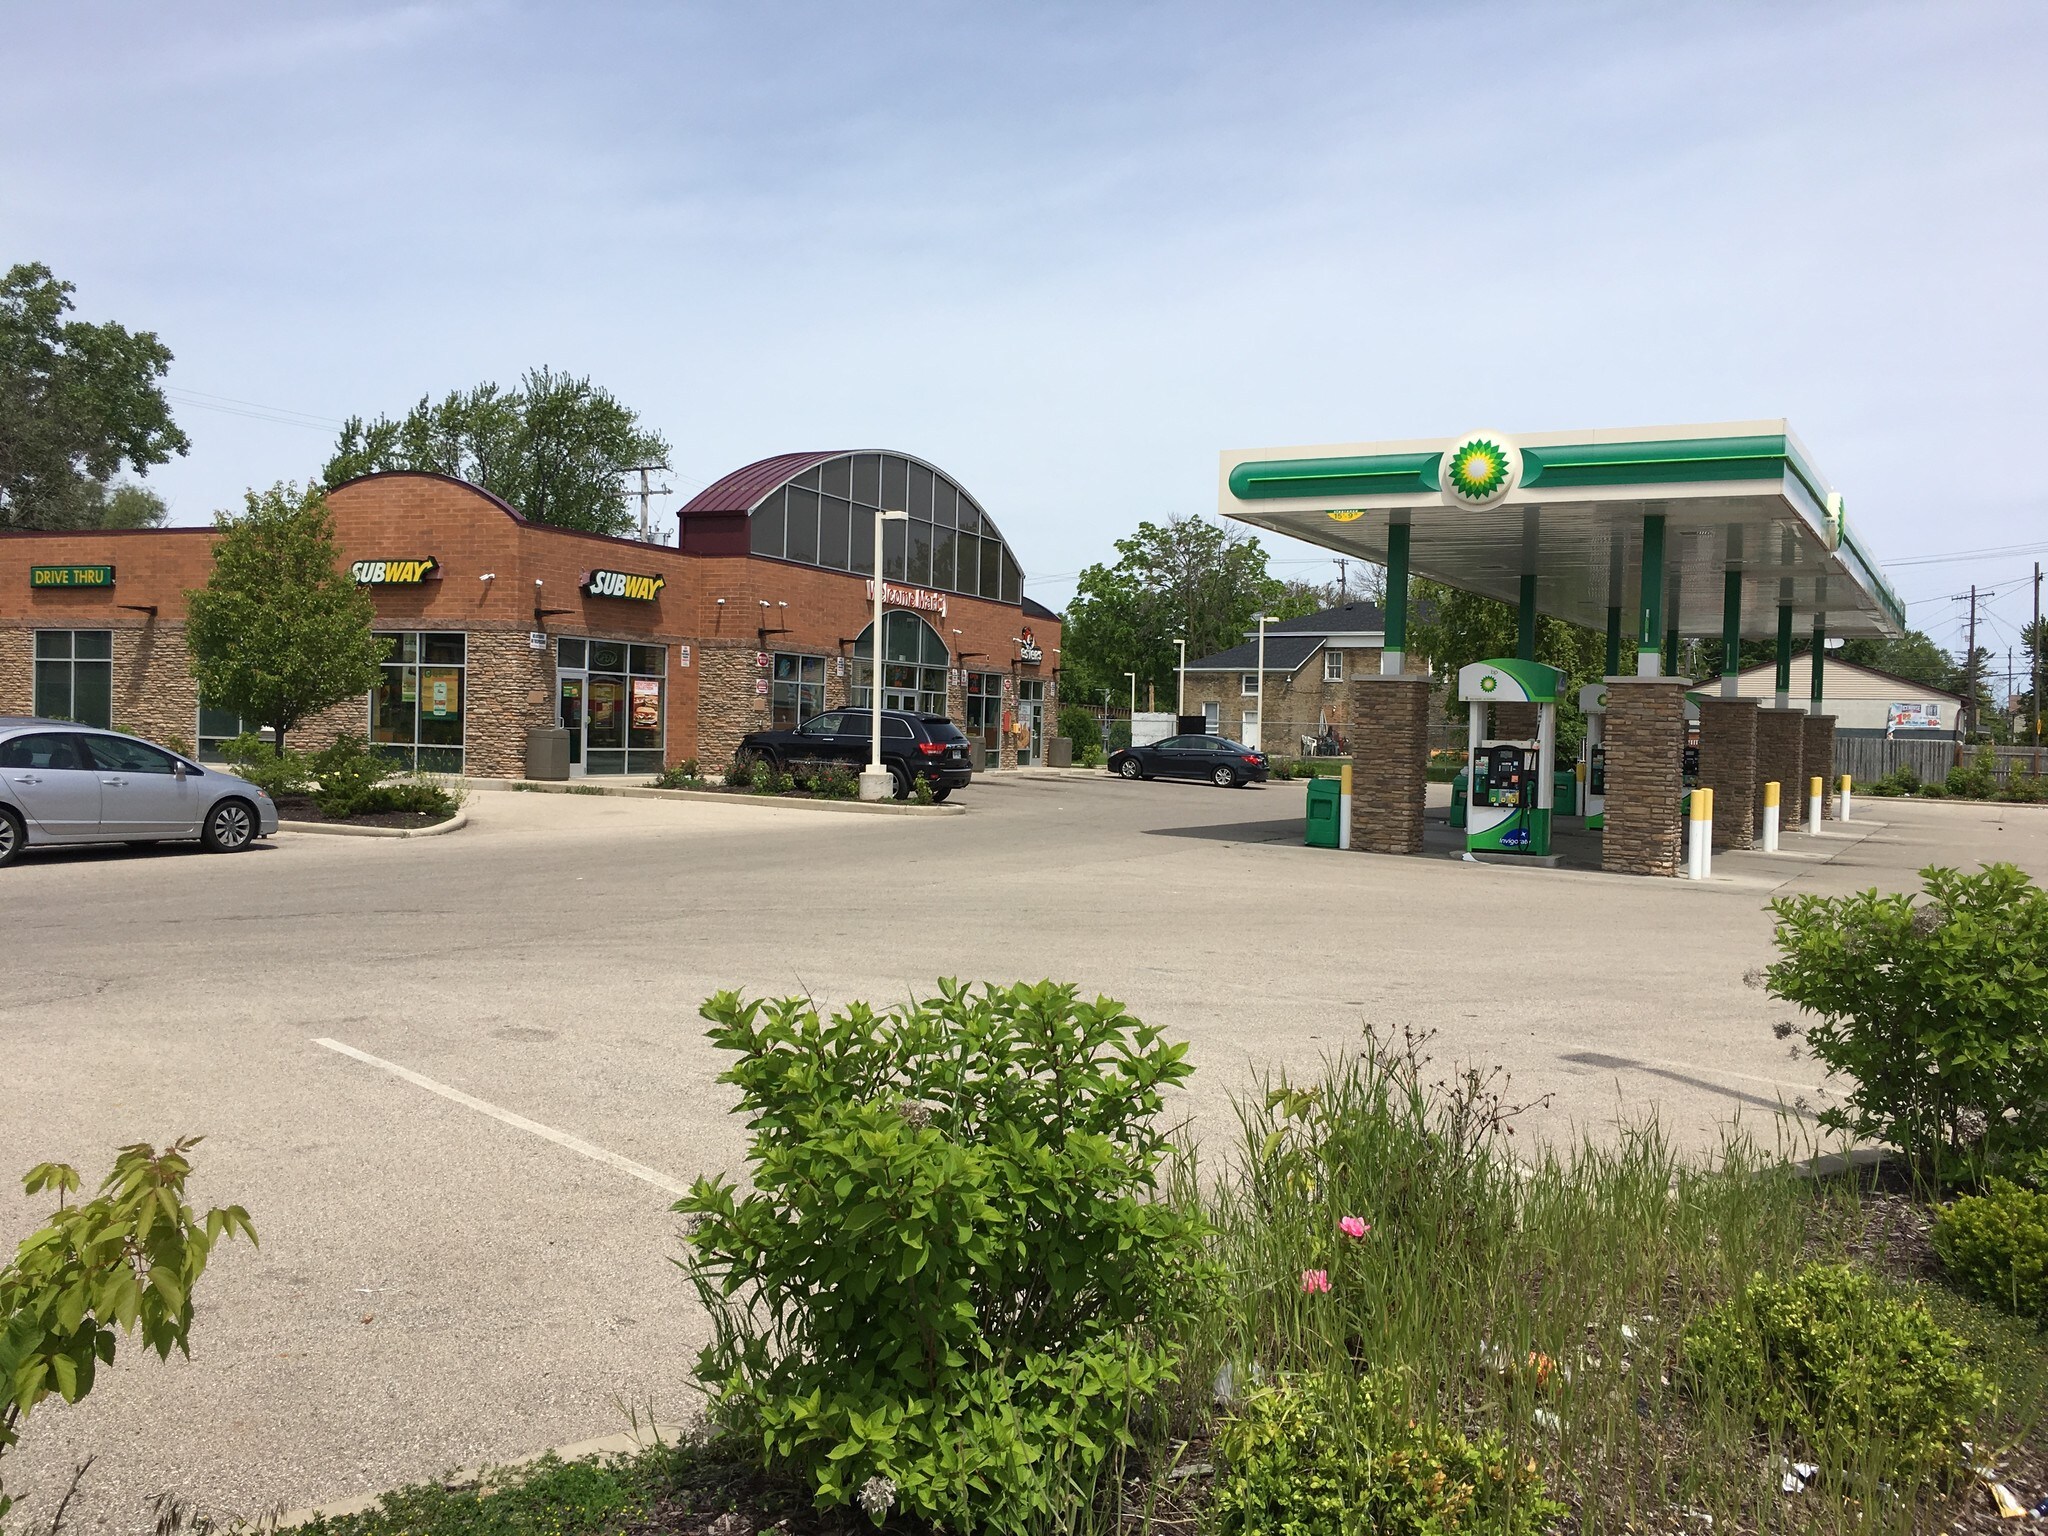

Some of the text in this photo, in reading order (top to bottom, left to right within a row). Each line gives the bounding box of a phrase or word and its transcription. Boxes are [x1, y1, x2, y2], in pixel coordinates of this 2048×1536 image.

[35, 570, 104, 584] DRIVE THRU
[352, 560, 434, 582] SUBWAY
[589, 571, 665, 600] SUBWAY
[865, 580, 916, 608] Wlcome
[1499, 837, 1532, 846] Invigoat
